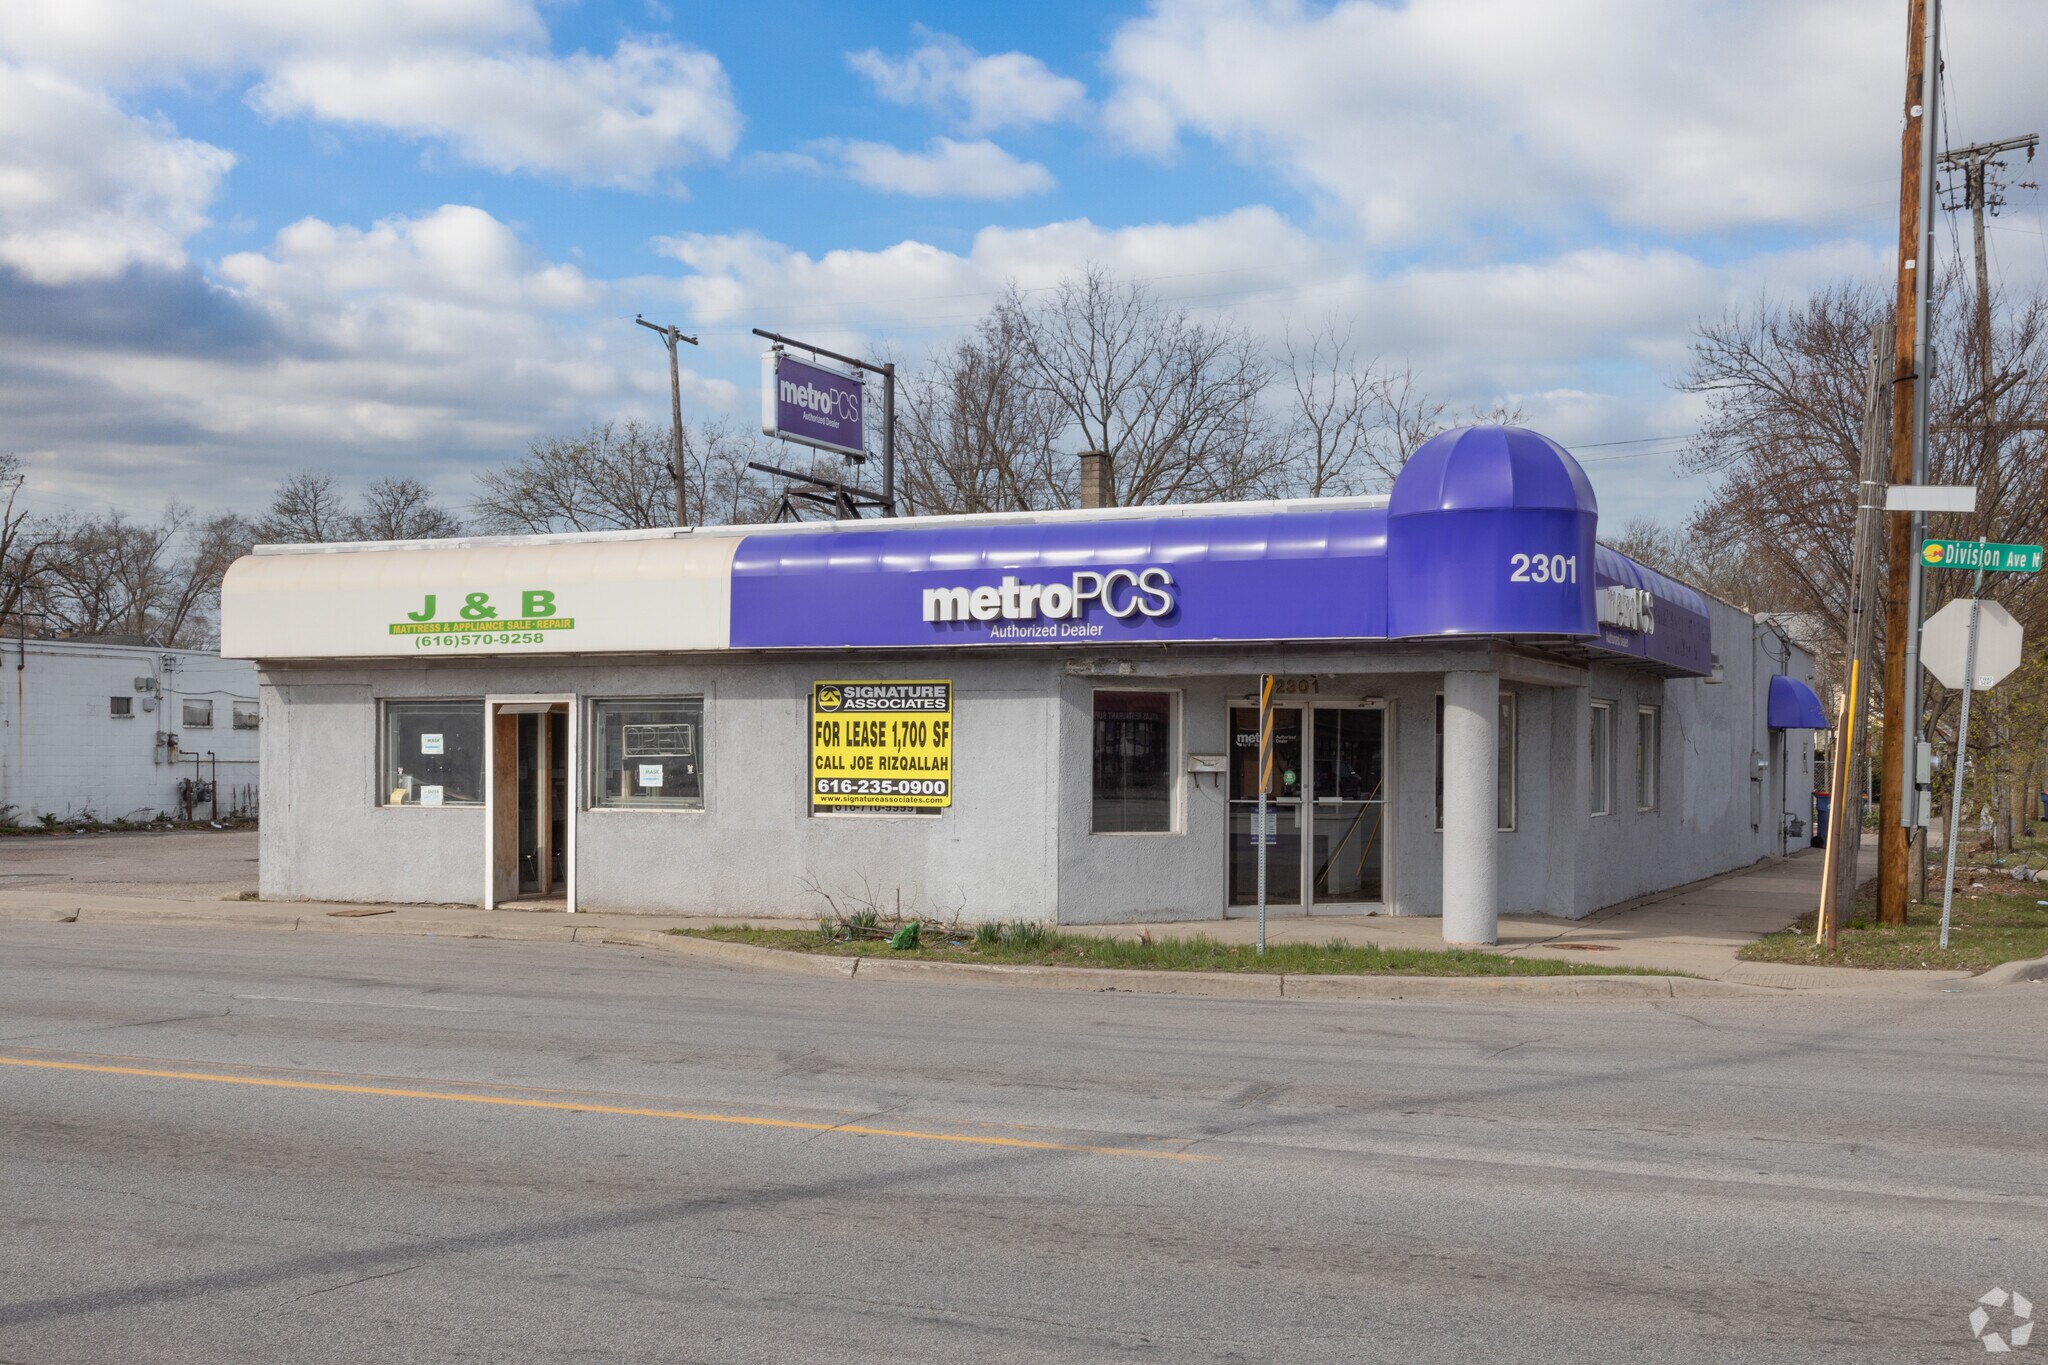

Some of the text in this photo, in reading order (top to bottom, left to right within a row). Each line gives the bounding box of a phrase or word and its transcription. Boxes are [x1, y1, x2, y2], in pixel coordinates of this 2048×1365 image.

[780, 379, 859, 422] metroPCS
[803, 411, 840, 428] Authorized Dealer
[1945, 543, 2041, 568] Division Ave N
[1510, 553, 1576, 584] 2301
[923, 567, 1174, 622] metroPCS
[407, 590, 557, 622] J & B
[393, 623, 441, 634] MATTRESS
[443, 622, 450, 632] &
[452, 621, 505, 632] APPLIANCE
[990, 622, 1104, 638] Authorized Dealer
[415, 633, 544, 649] (616)570-9258
[844, 686, 946, 698] SIGNATURE
[1276, 679, 1319, 694] 2301
[844, 699, 946, 709] ASSOCIATES
[816, 721, 949, 753] FOR LEASE 1,700 SF
[1236, 732, 1261, 743] met
[816, 755, 949, 771] CALL JOE RIZQALLAH
[818, 779, 946, 794] 616-235-0900
[820, 795, 943, 803] www.signatureassociates.com
